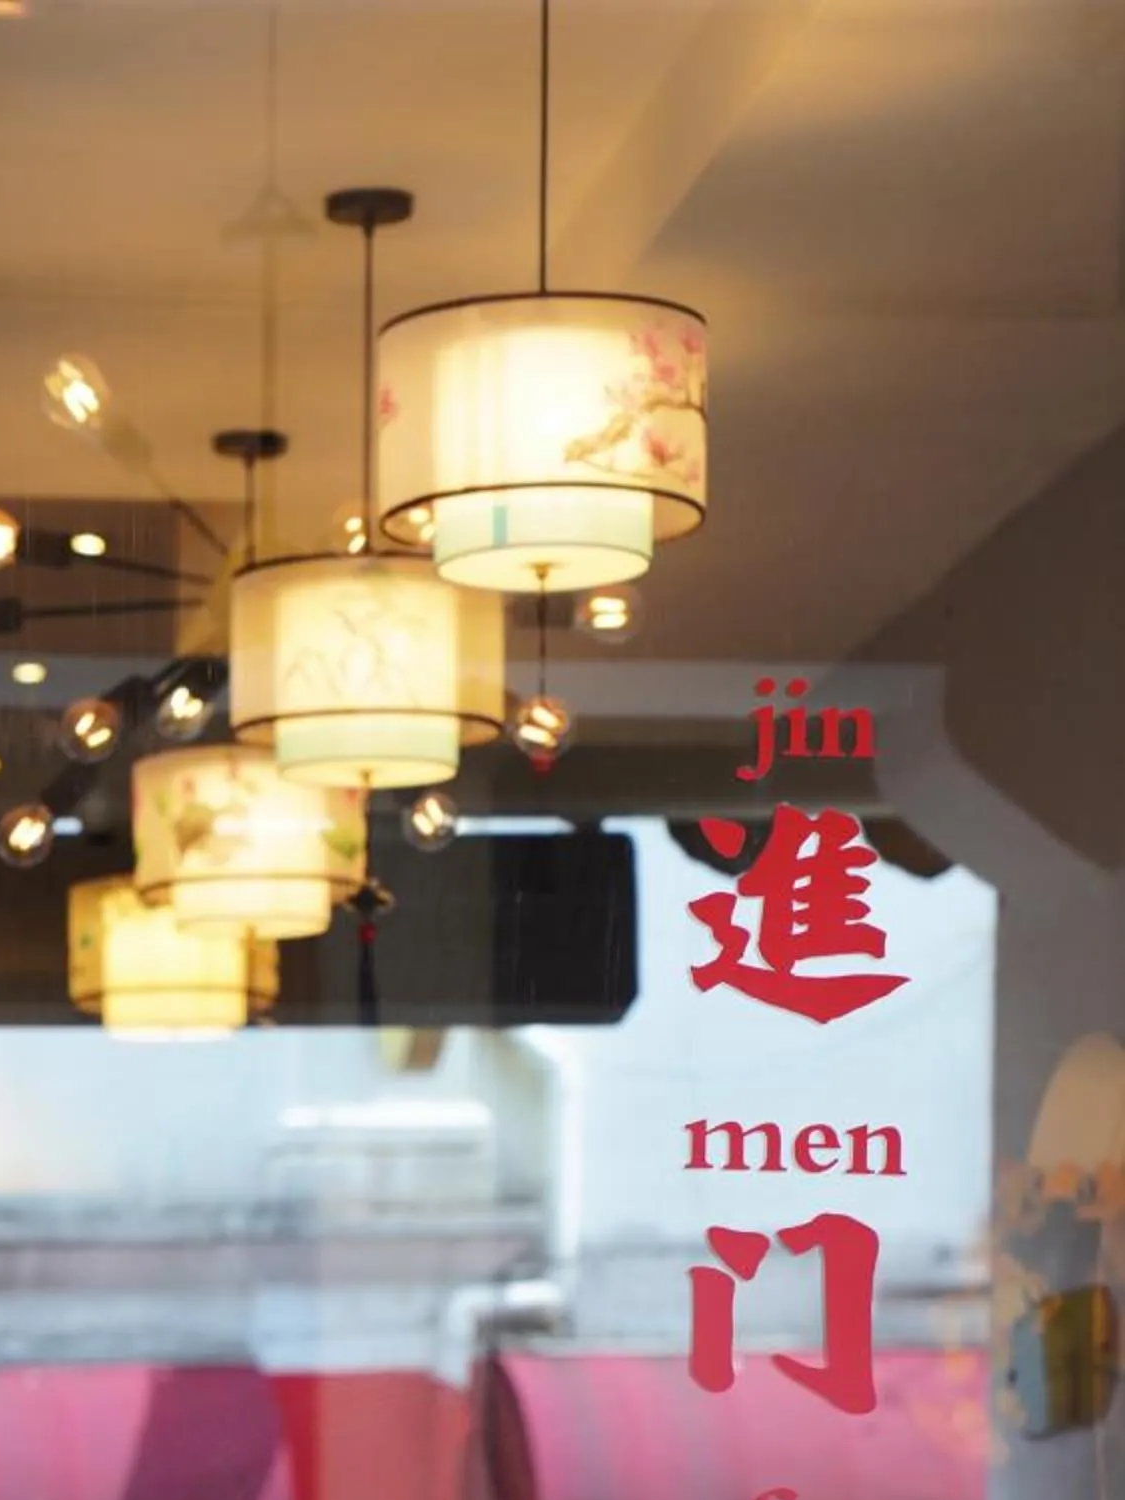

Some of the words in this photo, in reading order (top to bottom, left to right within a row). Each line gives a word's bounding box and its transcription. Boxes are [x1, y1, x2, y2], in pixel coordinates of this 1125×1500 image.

[736, 678, 877, 781] jin
[686, 803, 912, 1025] 進
[683, 1119, 908, 1176] men
[688, 1212, 880, 1415] 门
